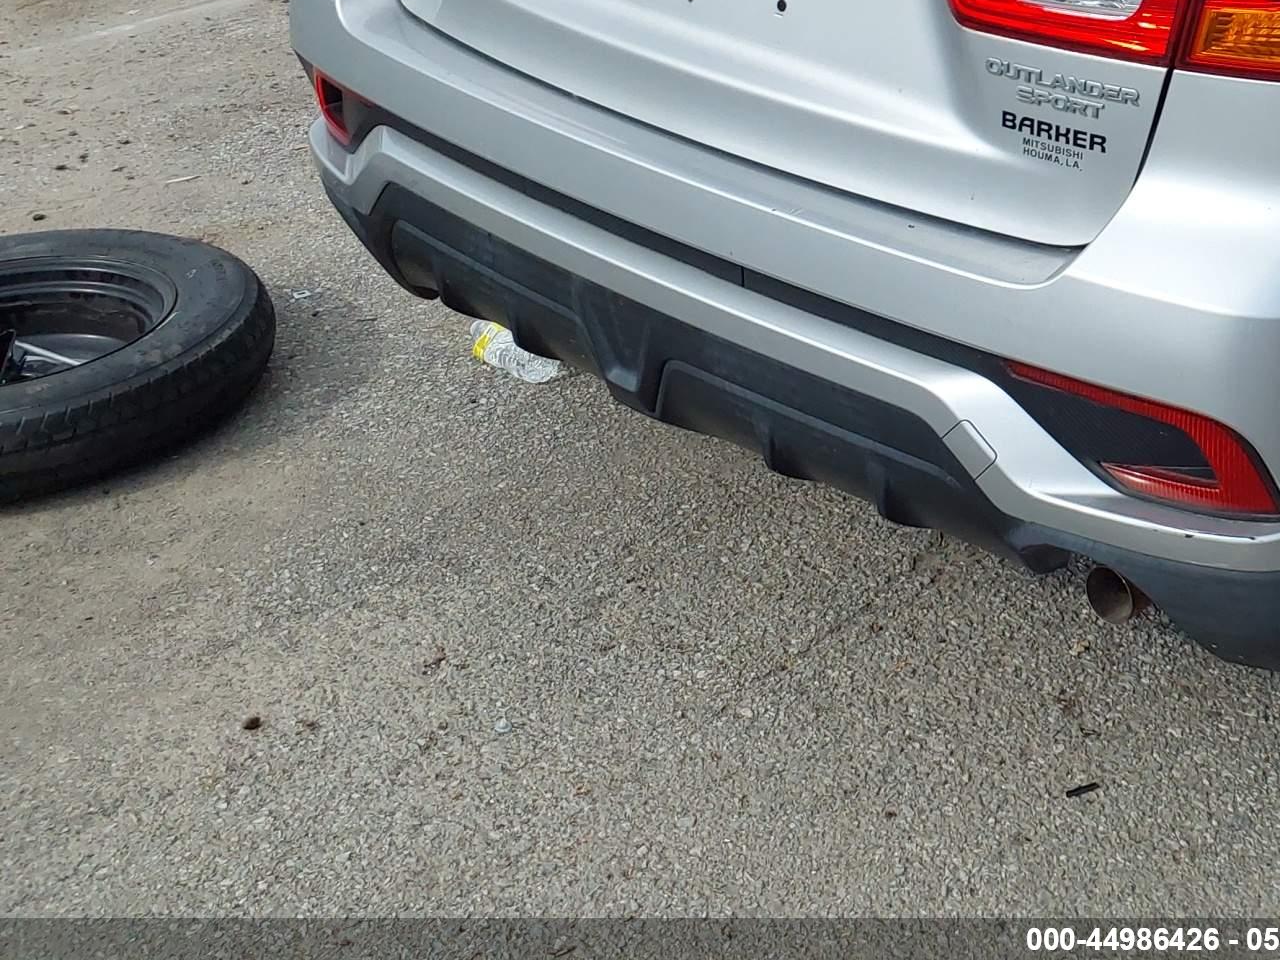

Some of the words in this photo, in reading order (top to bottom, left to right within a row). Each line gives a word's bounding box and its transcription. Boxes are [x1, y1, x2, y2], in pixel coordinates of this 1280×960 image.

[985, 57, 1140, 107] OUTLANDER
[1016, 85, 1105, 119] SPORT
[1001, 110, 1107, 153] BARKER
[1022, 137, 1084, 161] MITSUBISHI
[1023, 147, 1064, 166] HOUMA,
